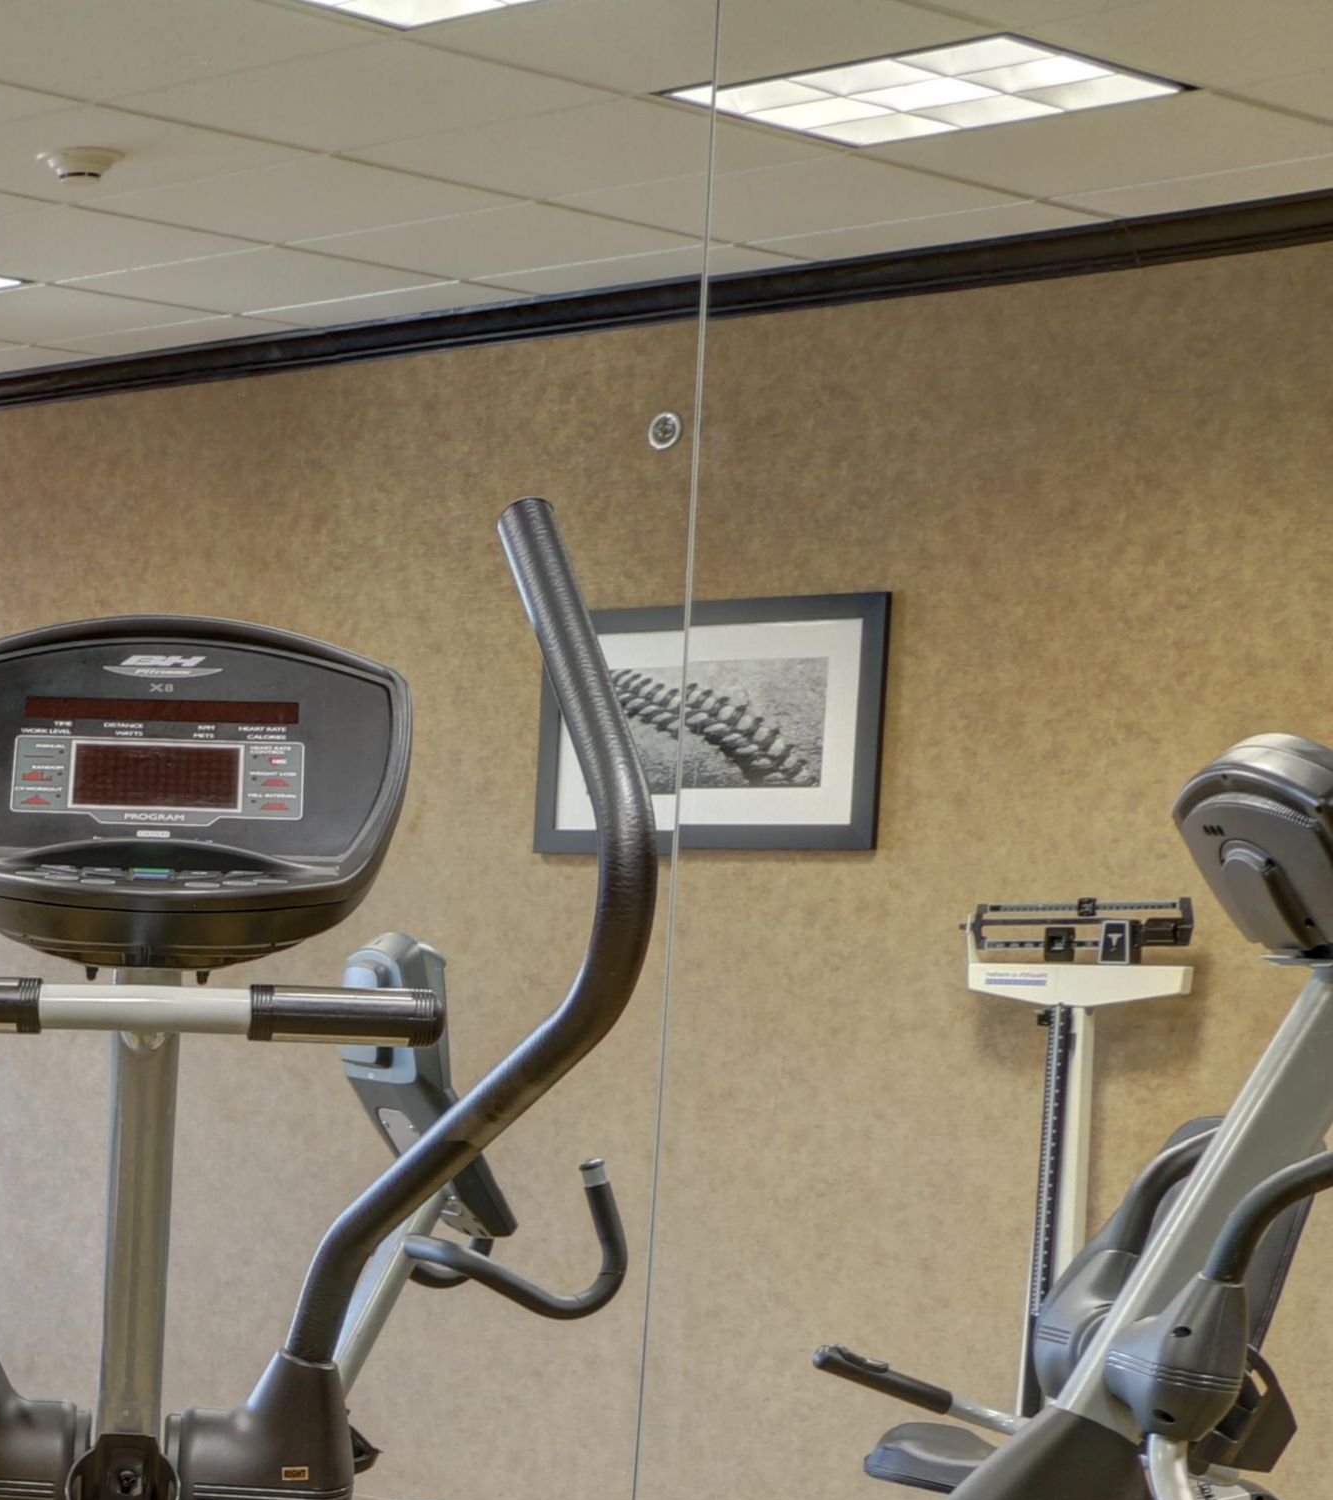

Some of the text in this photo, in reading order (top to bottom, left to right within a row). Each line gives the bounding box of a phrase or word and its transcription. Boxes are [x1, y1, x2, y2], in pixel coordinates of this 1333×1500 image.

[120, 655, 207, 667] BH
[149, 683, 174, 693] X8
[103, 721, 144, 729] DISTANCE
[124, 812, 185, 822] PROGRAM
